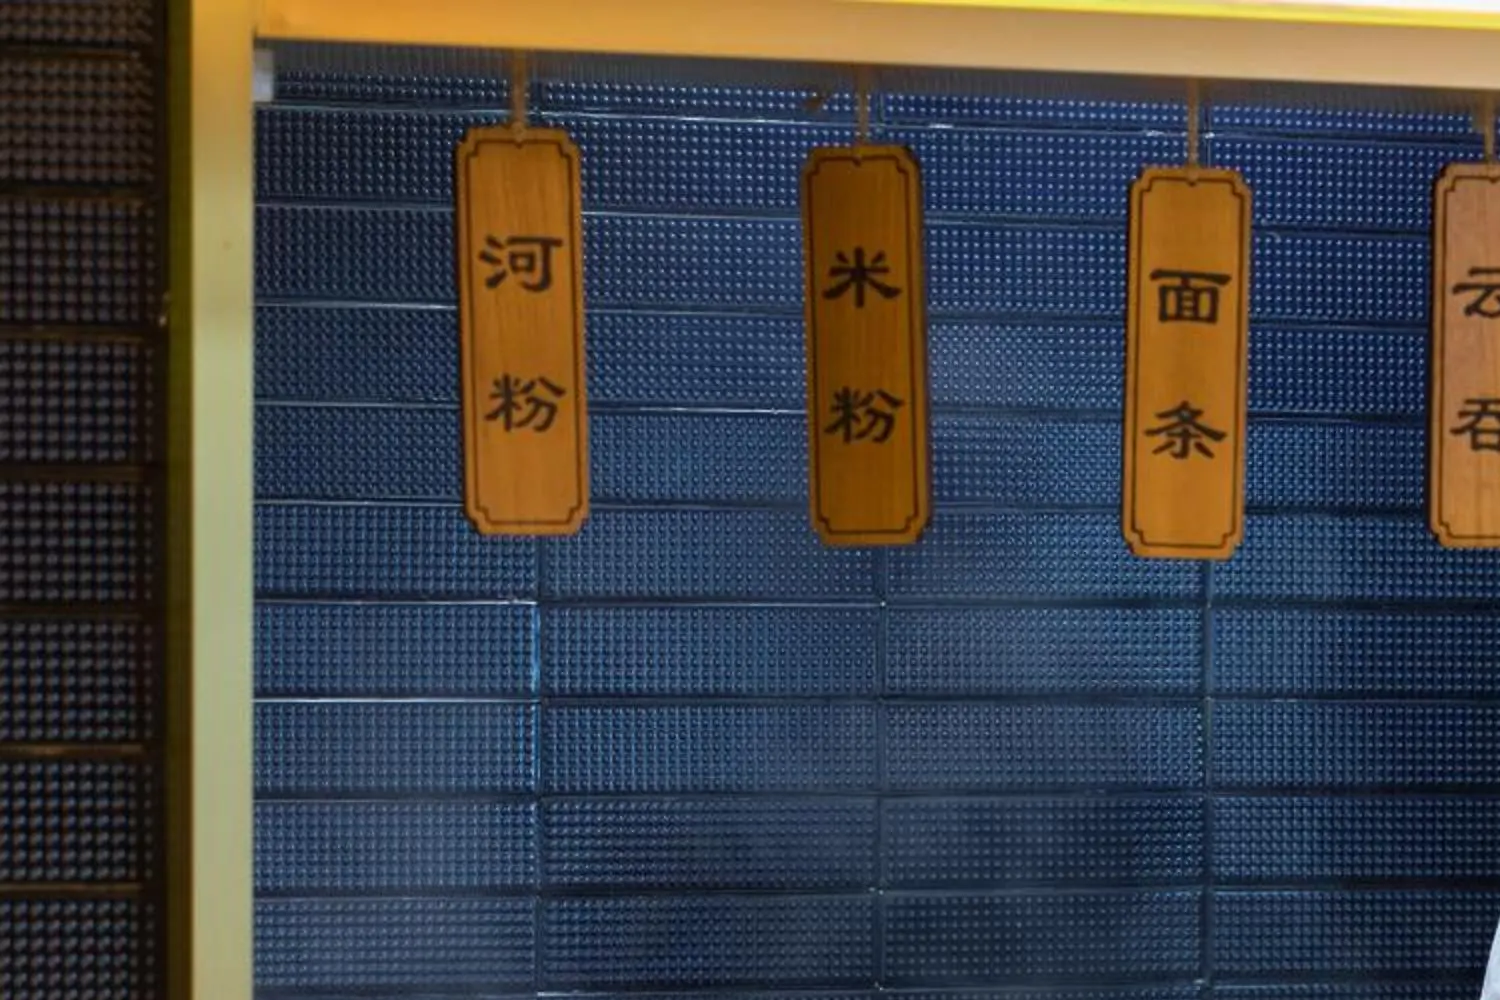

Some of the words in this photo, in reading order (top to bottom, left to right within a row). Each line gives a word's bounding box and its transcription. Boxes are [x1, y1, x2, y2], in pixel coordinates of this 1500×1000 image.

[478, 235, 566, 433] 河粉
[822, 246, 904, 445] 米粉
[1145, 268, 1232, 460] 面条
